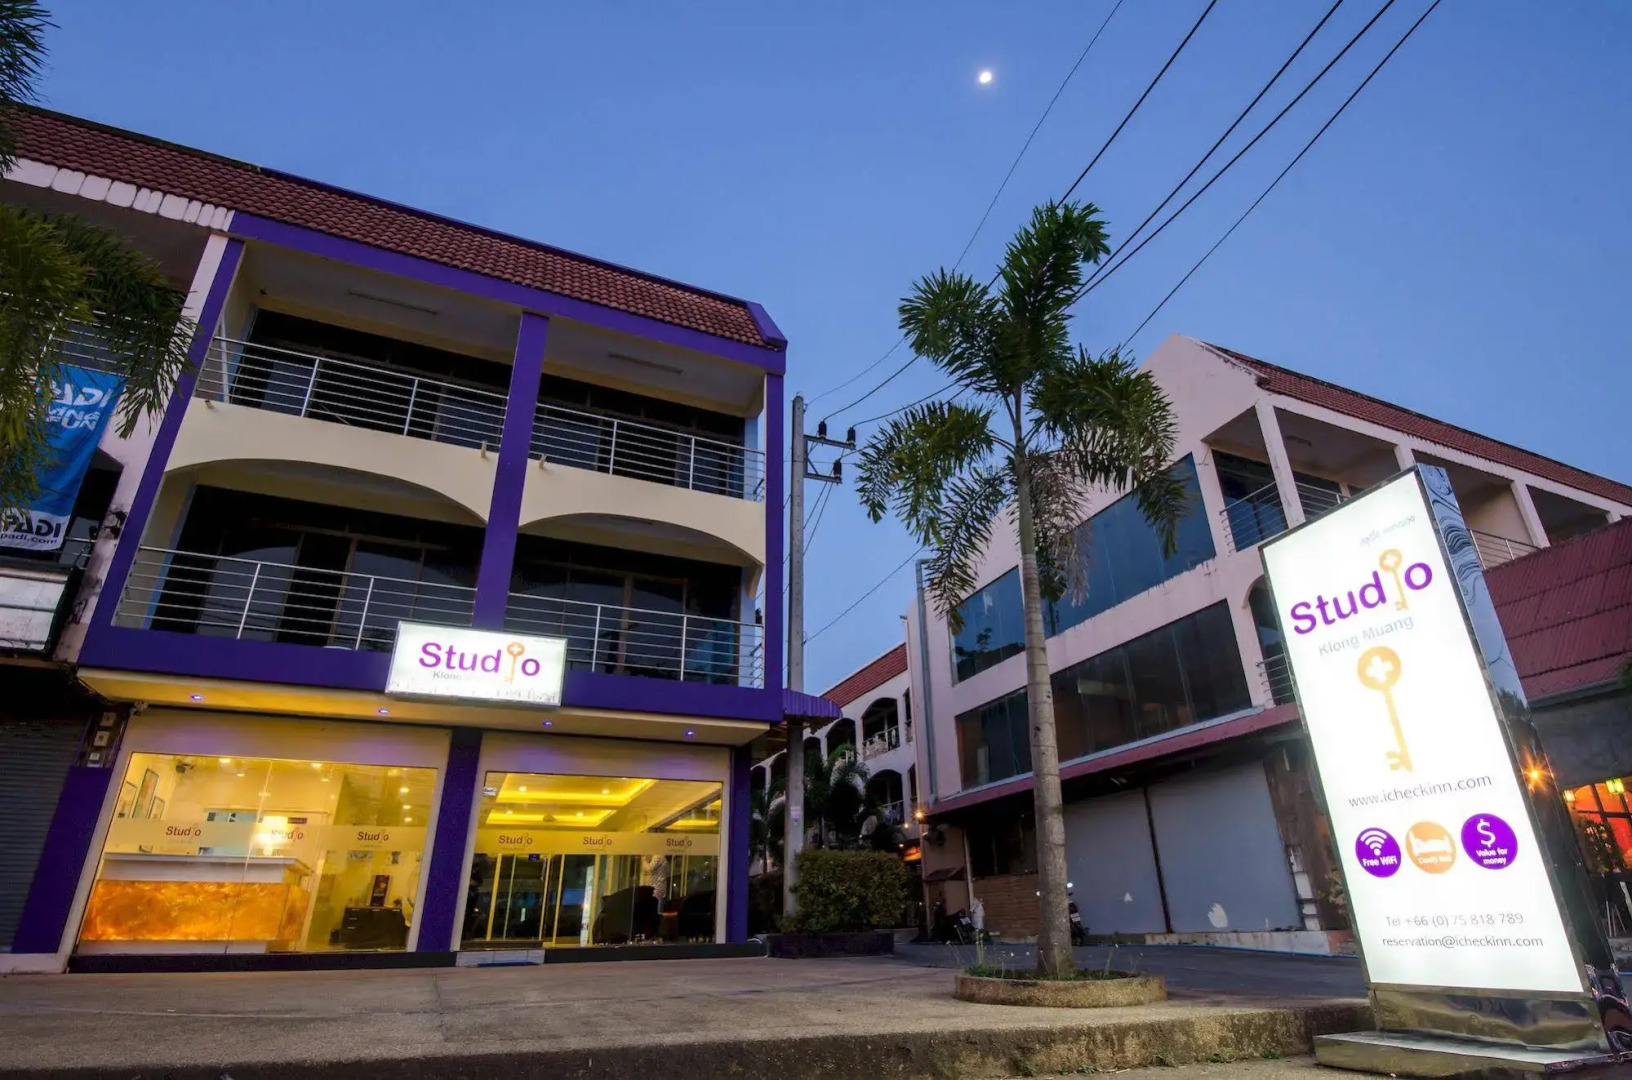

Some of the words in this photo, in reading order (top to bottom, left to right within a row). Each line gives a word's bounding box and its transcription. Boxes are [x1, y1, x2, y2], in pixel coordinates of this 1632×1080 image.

[42, 380, 112, 408] ADI
[1, 533, 58, 544] padi.com
[1290, 549, 1433, 635] Studio
[1319, 633, 1359, 657] Klong
[1362, 616, 1414, 642] Muang
[419, 641, 541, 683] Studio
[1348, 775, 1492, 807] www.icheckinn.com
[1362, 858, 1379, 867] Free
[1380, 855, 1397, 865] WiFi
[1476, 850, 1496, 858] Value
[1497, 848, 1508, 856] for
[1483, 857, 1507, 865] money
[1406, 915, 1428, 926] +66
[1432, 915, 1449, 928] (0)
[1453, 915, 1467, 926] 75
[1471, 913, 1495, 926] 818
[1499, 912, 1524, 925] 789
[1382, 935, 1544, 949] reservation@icheckinn.com
